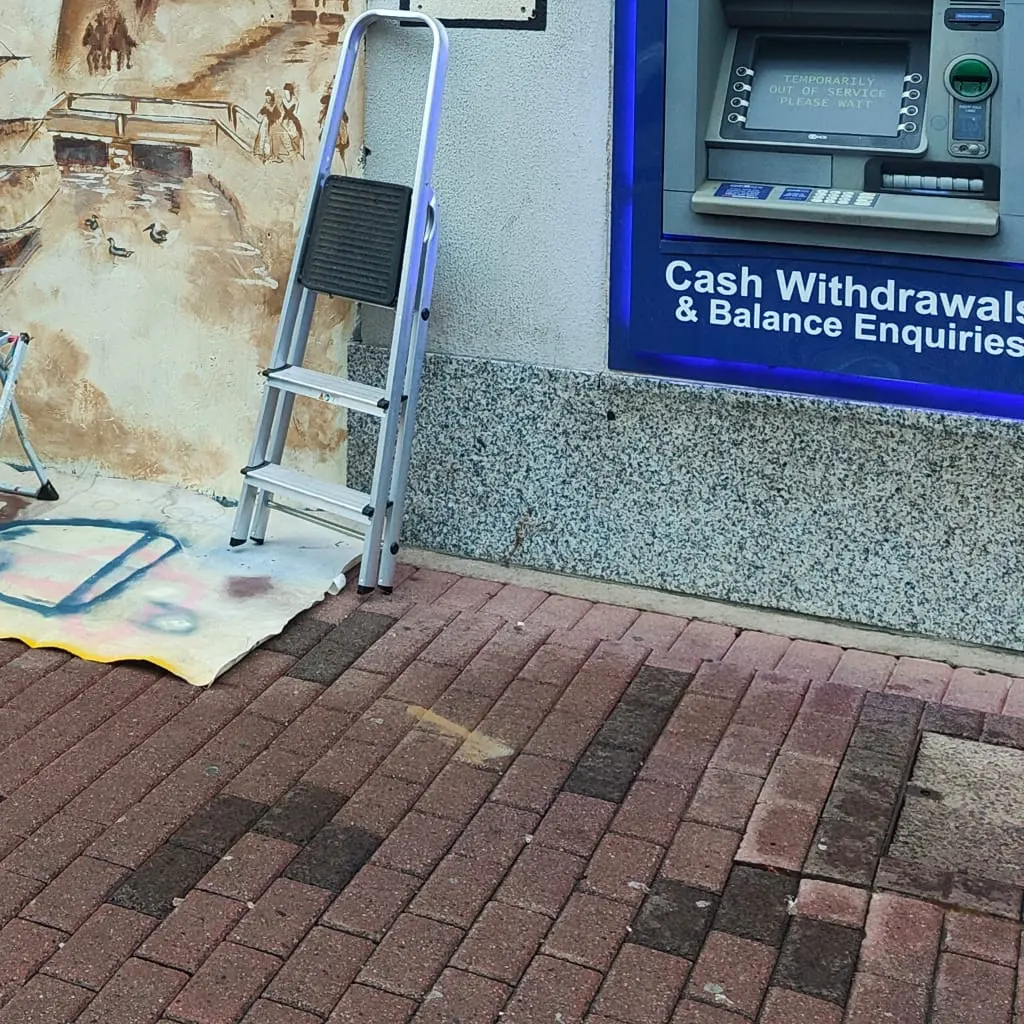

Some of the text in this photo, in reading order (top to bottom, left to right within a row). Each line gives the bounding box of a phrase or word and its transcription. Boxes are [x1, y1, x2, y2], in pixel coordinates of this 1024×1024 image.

[784, 74, 876, 87] TEMPORARILY
[769, 85, 887, 98] OUT OF SERVICE
[780, 97, 873, 109] PLEASE WAIT
[665, 260, 763, 298] Cash
[675, 295, 1024, 358] & Balance Enquiries
